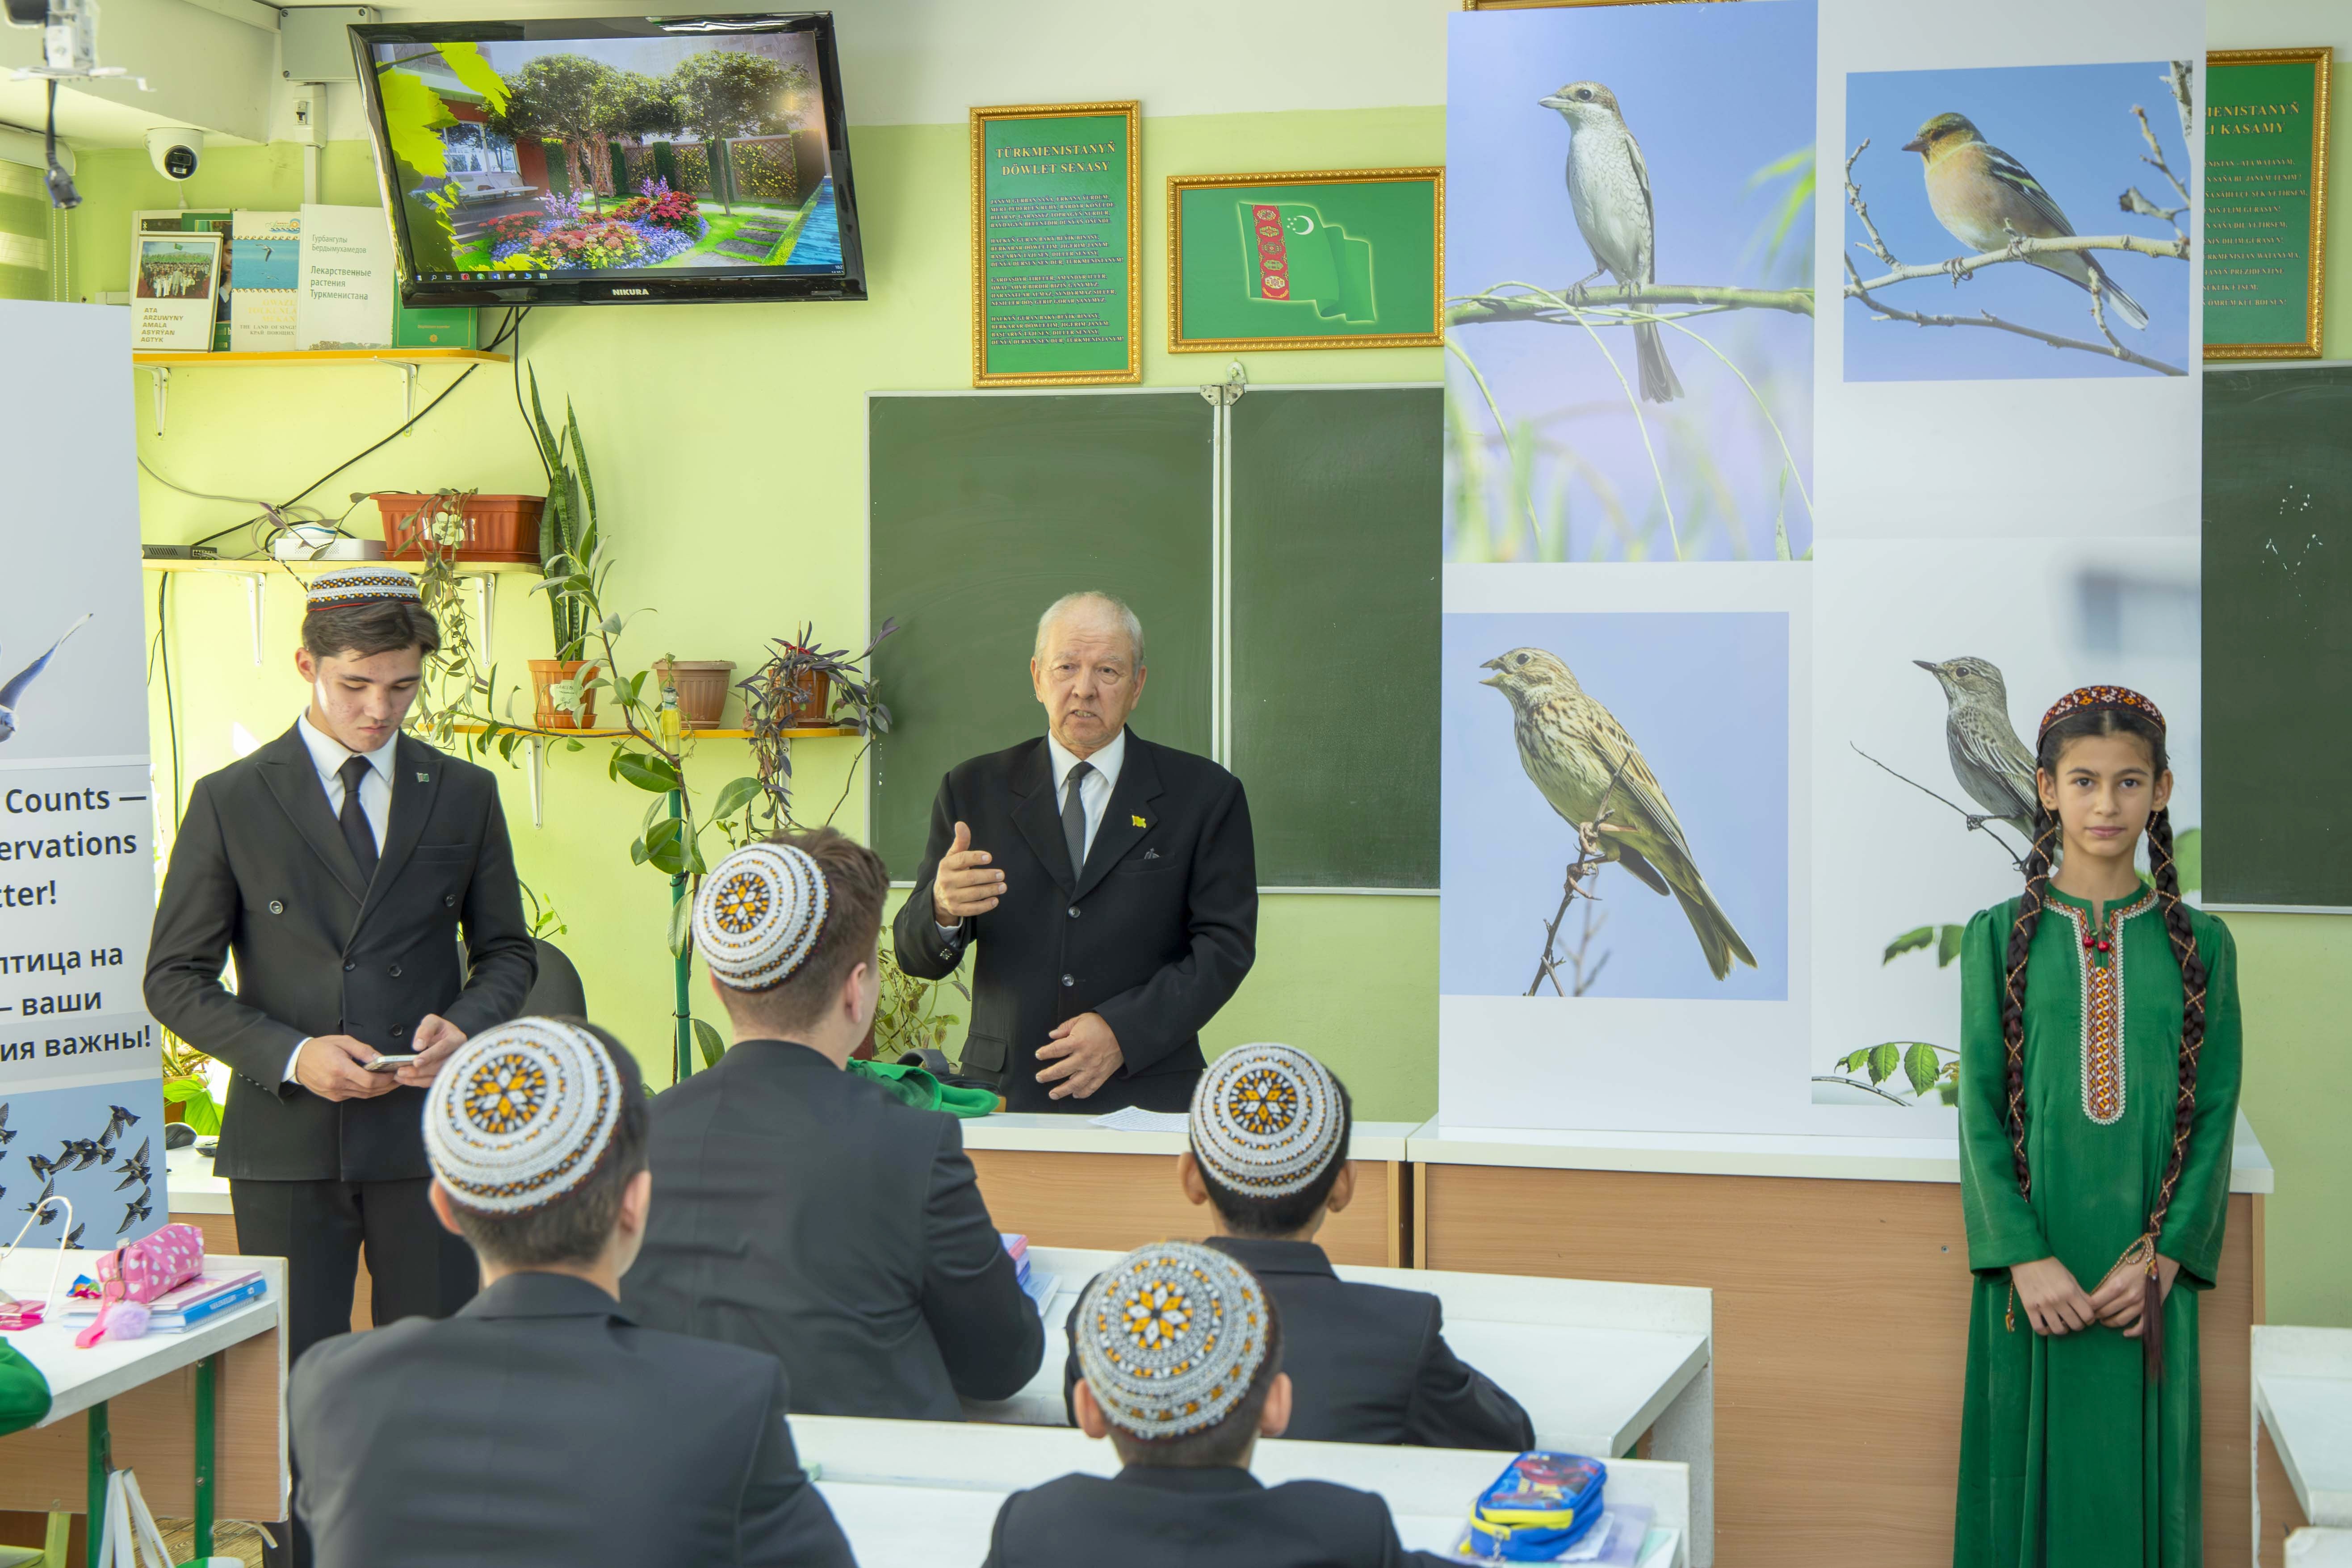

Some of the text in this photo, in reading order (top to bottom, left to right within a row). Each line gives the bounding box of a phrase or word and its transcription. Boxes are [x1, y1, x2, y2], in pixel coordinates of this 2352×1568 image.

[2221, 122, 2285, 135] KASAMY
[995, 140, 1115, 158] TÜRKMENISTANYŇ
[1002, 161, 1110, 176] DÖWLET SENASY
[312, 235, 348, 243] Гурбангулы
[312, 244, 366, 253] Бердымухамедов
[311, 266, 372, 277] Лекарственные
[310, 289, 368, 300] Туркменистана
[6, 788, 110, 813] Counts
[0, 880, 56, 908] ter!
[91, 948, 123, 967] на
[22, 992, 101, 1016] ваши
[45, 1025, 151, 1057] важны!
